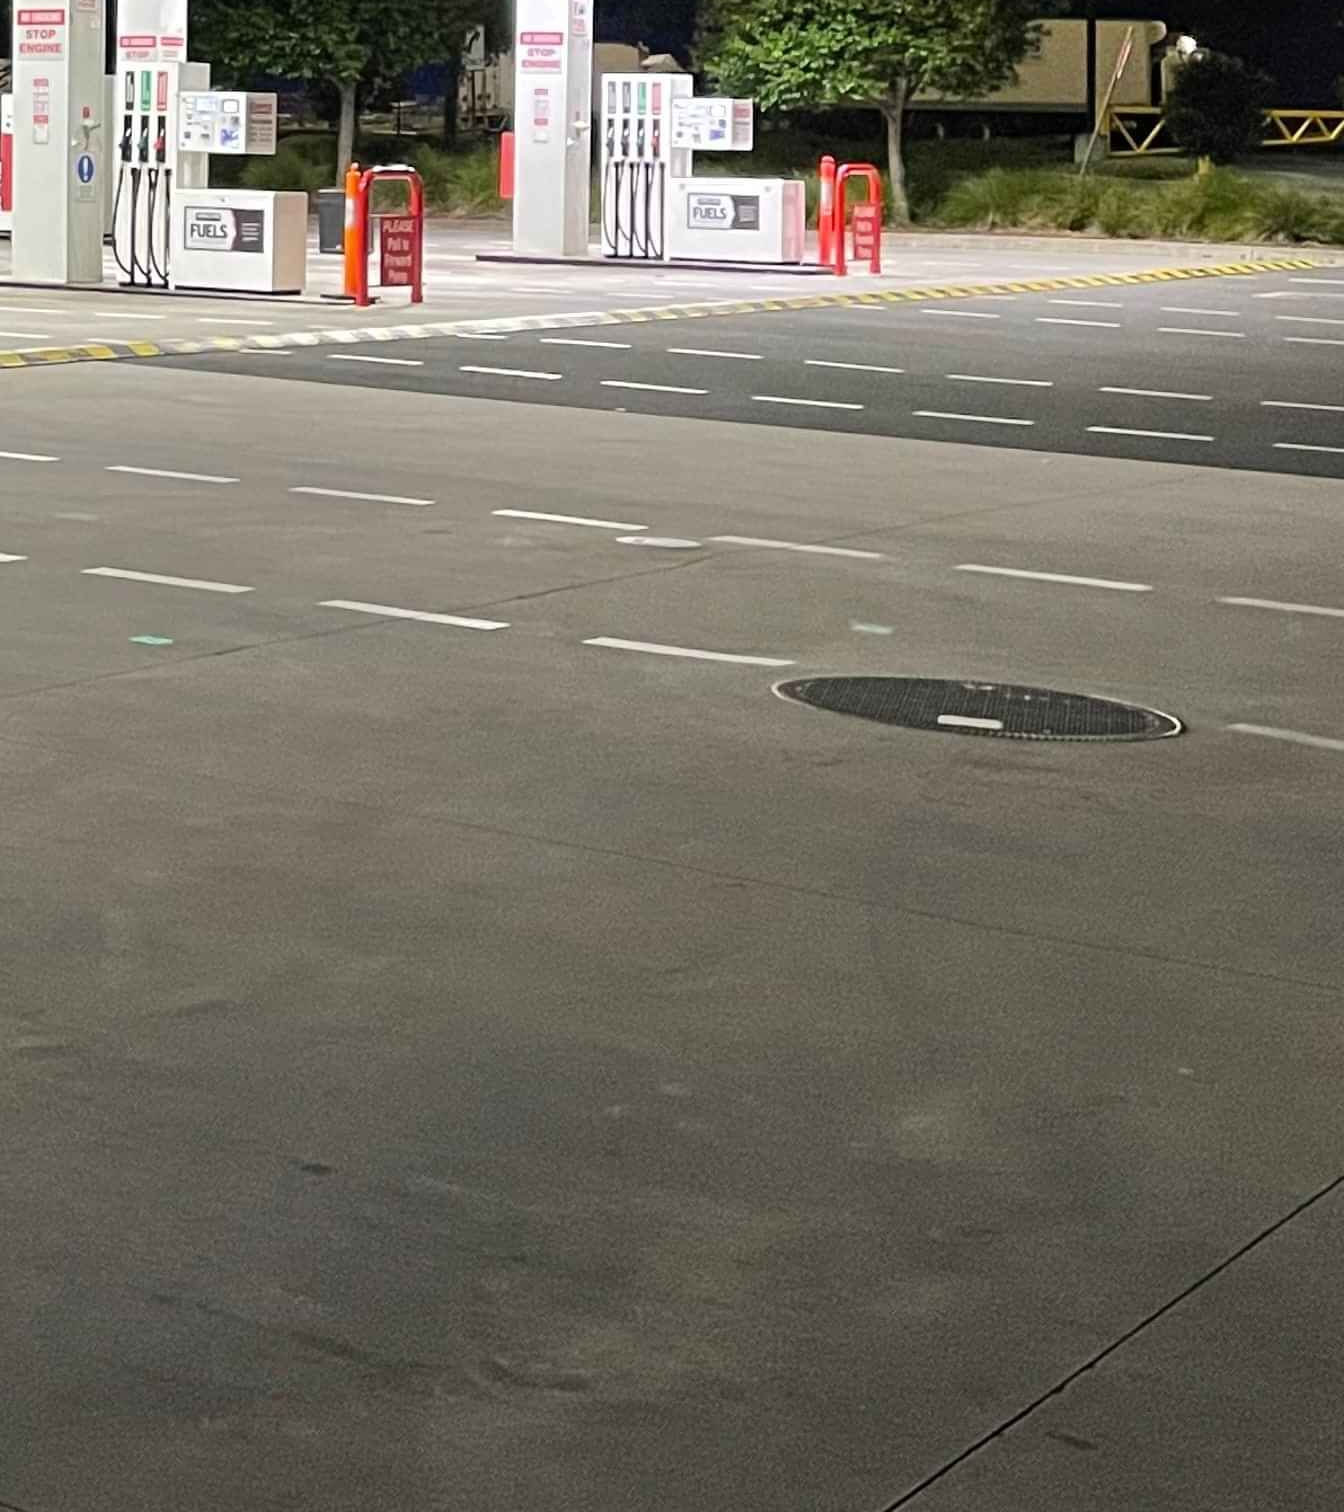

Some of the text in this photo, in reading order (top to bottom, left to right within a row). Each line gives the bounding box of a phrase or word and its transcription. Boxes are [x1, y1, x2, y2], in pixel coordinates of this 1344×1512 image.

[25, 29, 57, 39] STOP
[19, 43, 63, 53] ENGINE
[693, 207, 727, 219] FUELS
[190, 223, 227, 238] FUELS
